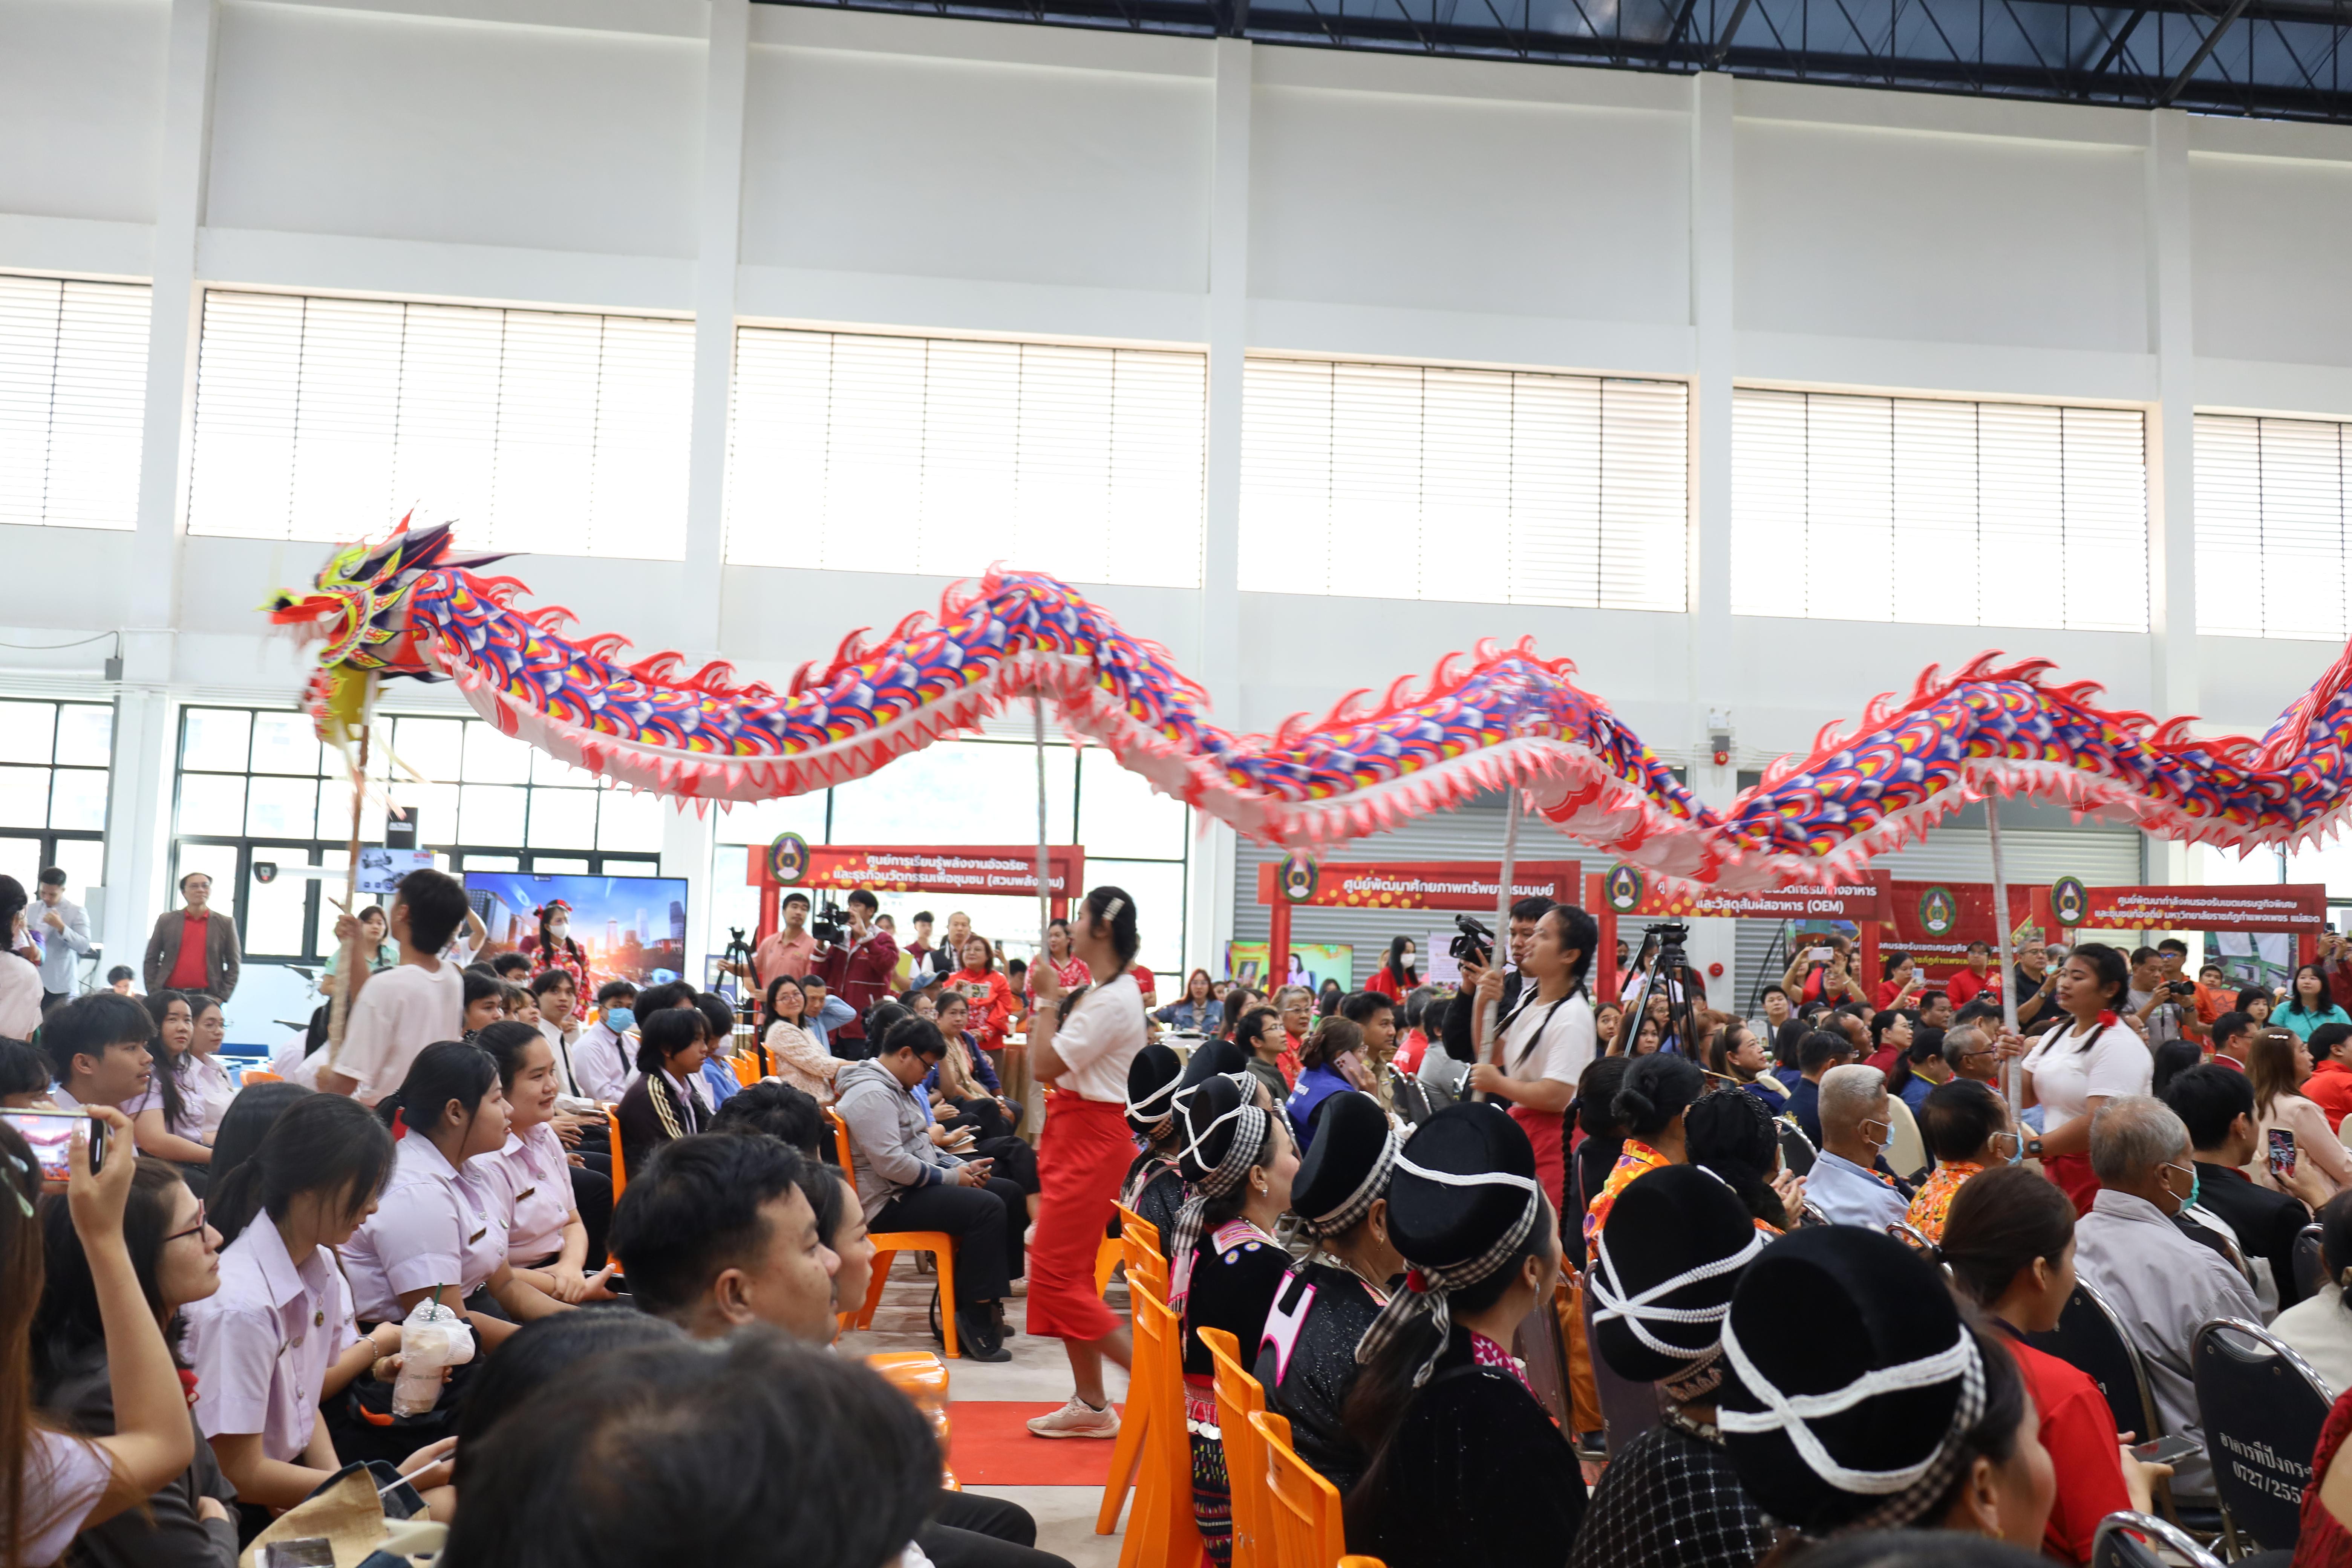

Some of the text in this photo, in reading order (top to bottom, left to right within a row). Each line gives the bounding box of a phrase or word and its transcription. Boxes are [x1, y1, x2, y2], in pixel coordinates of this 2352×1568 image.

[867, 853, 1029, 871] ศูนย์การเรียนรู้พลังงานอัจฉริยะ
[833, 868, 1065, 890] และธุรกิจนวัตกรรมเพื่อชุมชน (สวนพลังาน)
[1343, 877, 1554, 897] ศูนย์พัฒนาศักยภาพทรัพยารมนุษย์
[1696, 896, 1844, 914] และวัสดุสัมผัสอาหาร (OEM)
[2290, 913, 2320, 923] แม่สอด
[2233, 1461, 2305, 1504] 0727/255
